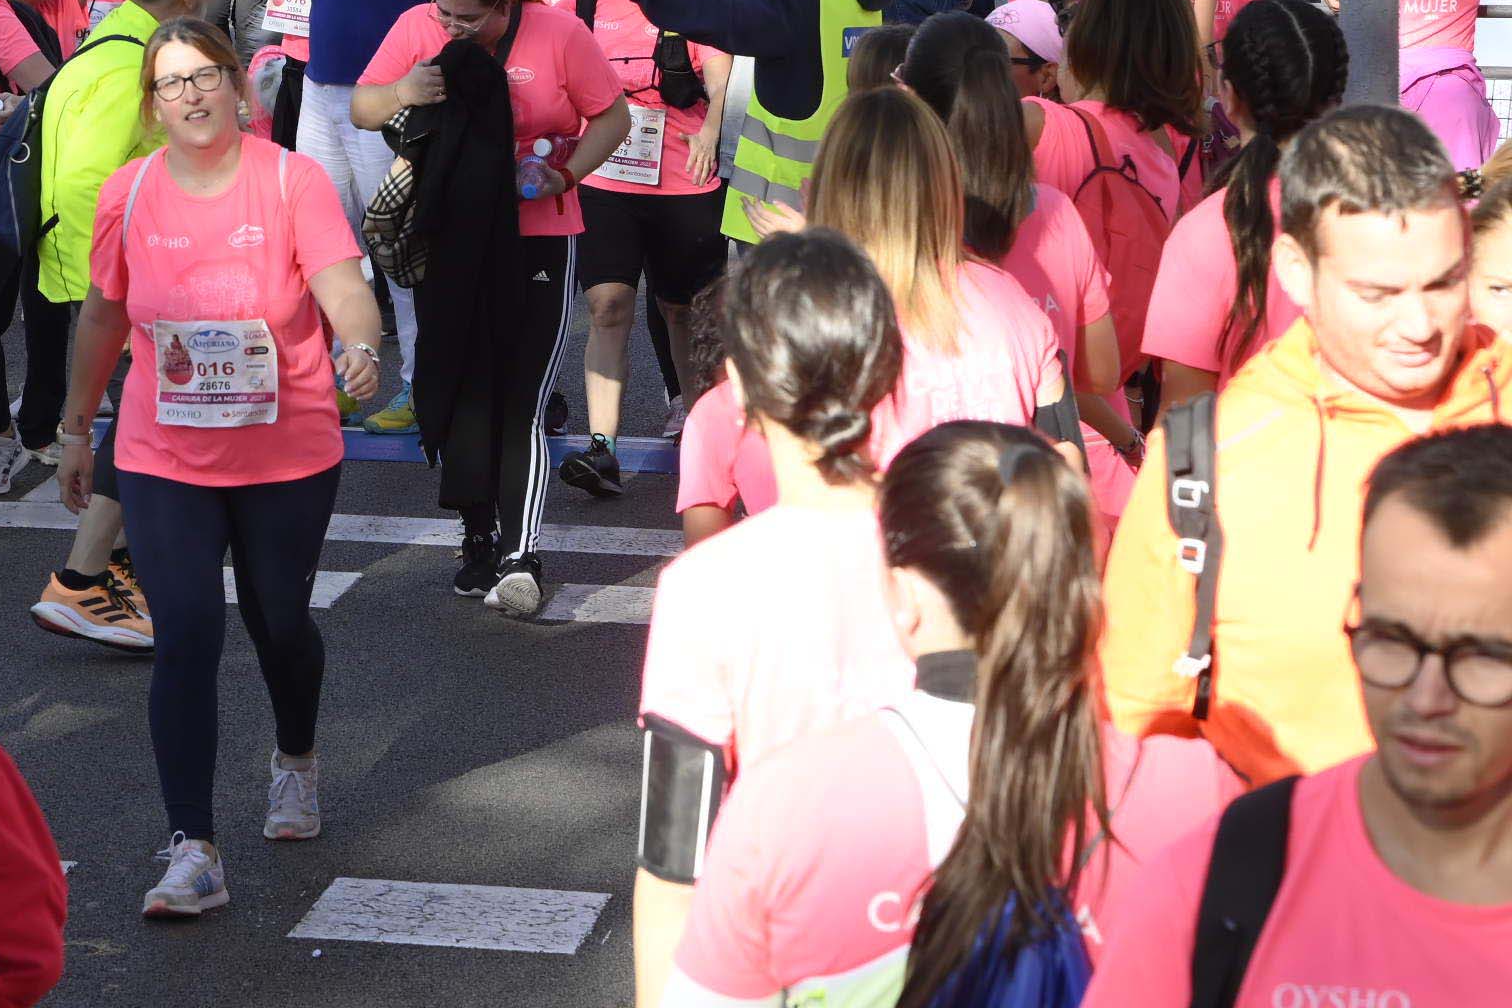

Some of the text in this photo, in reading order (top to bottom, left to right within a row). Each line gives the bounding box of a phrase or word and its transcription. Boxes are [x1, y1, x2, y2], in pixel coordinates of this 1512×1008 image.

[1404, 0, 1458, 13] MUJER
[192, 338, 236, 348] ASTURIANA
[197, 361, 236, 377] 016
[199, 381, 231, 392] 28676
